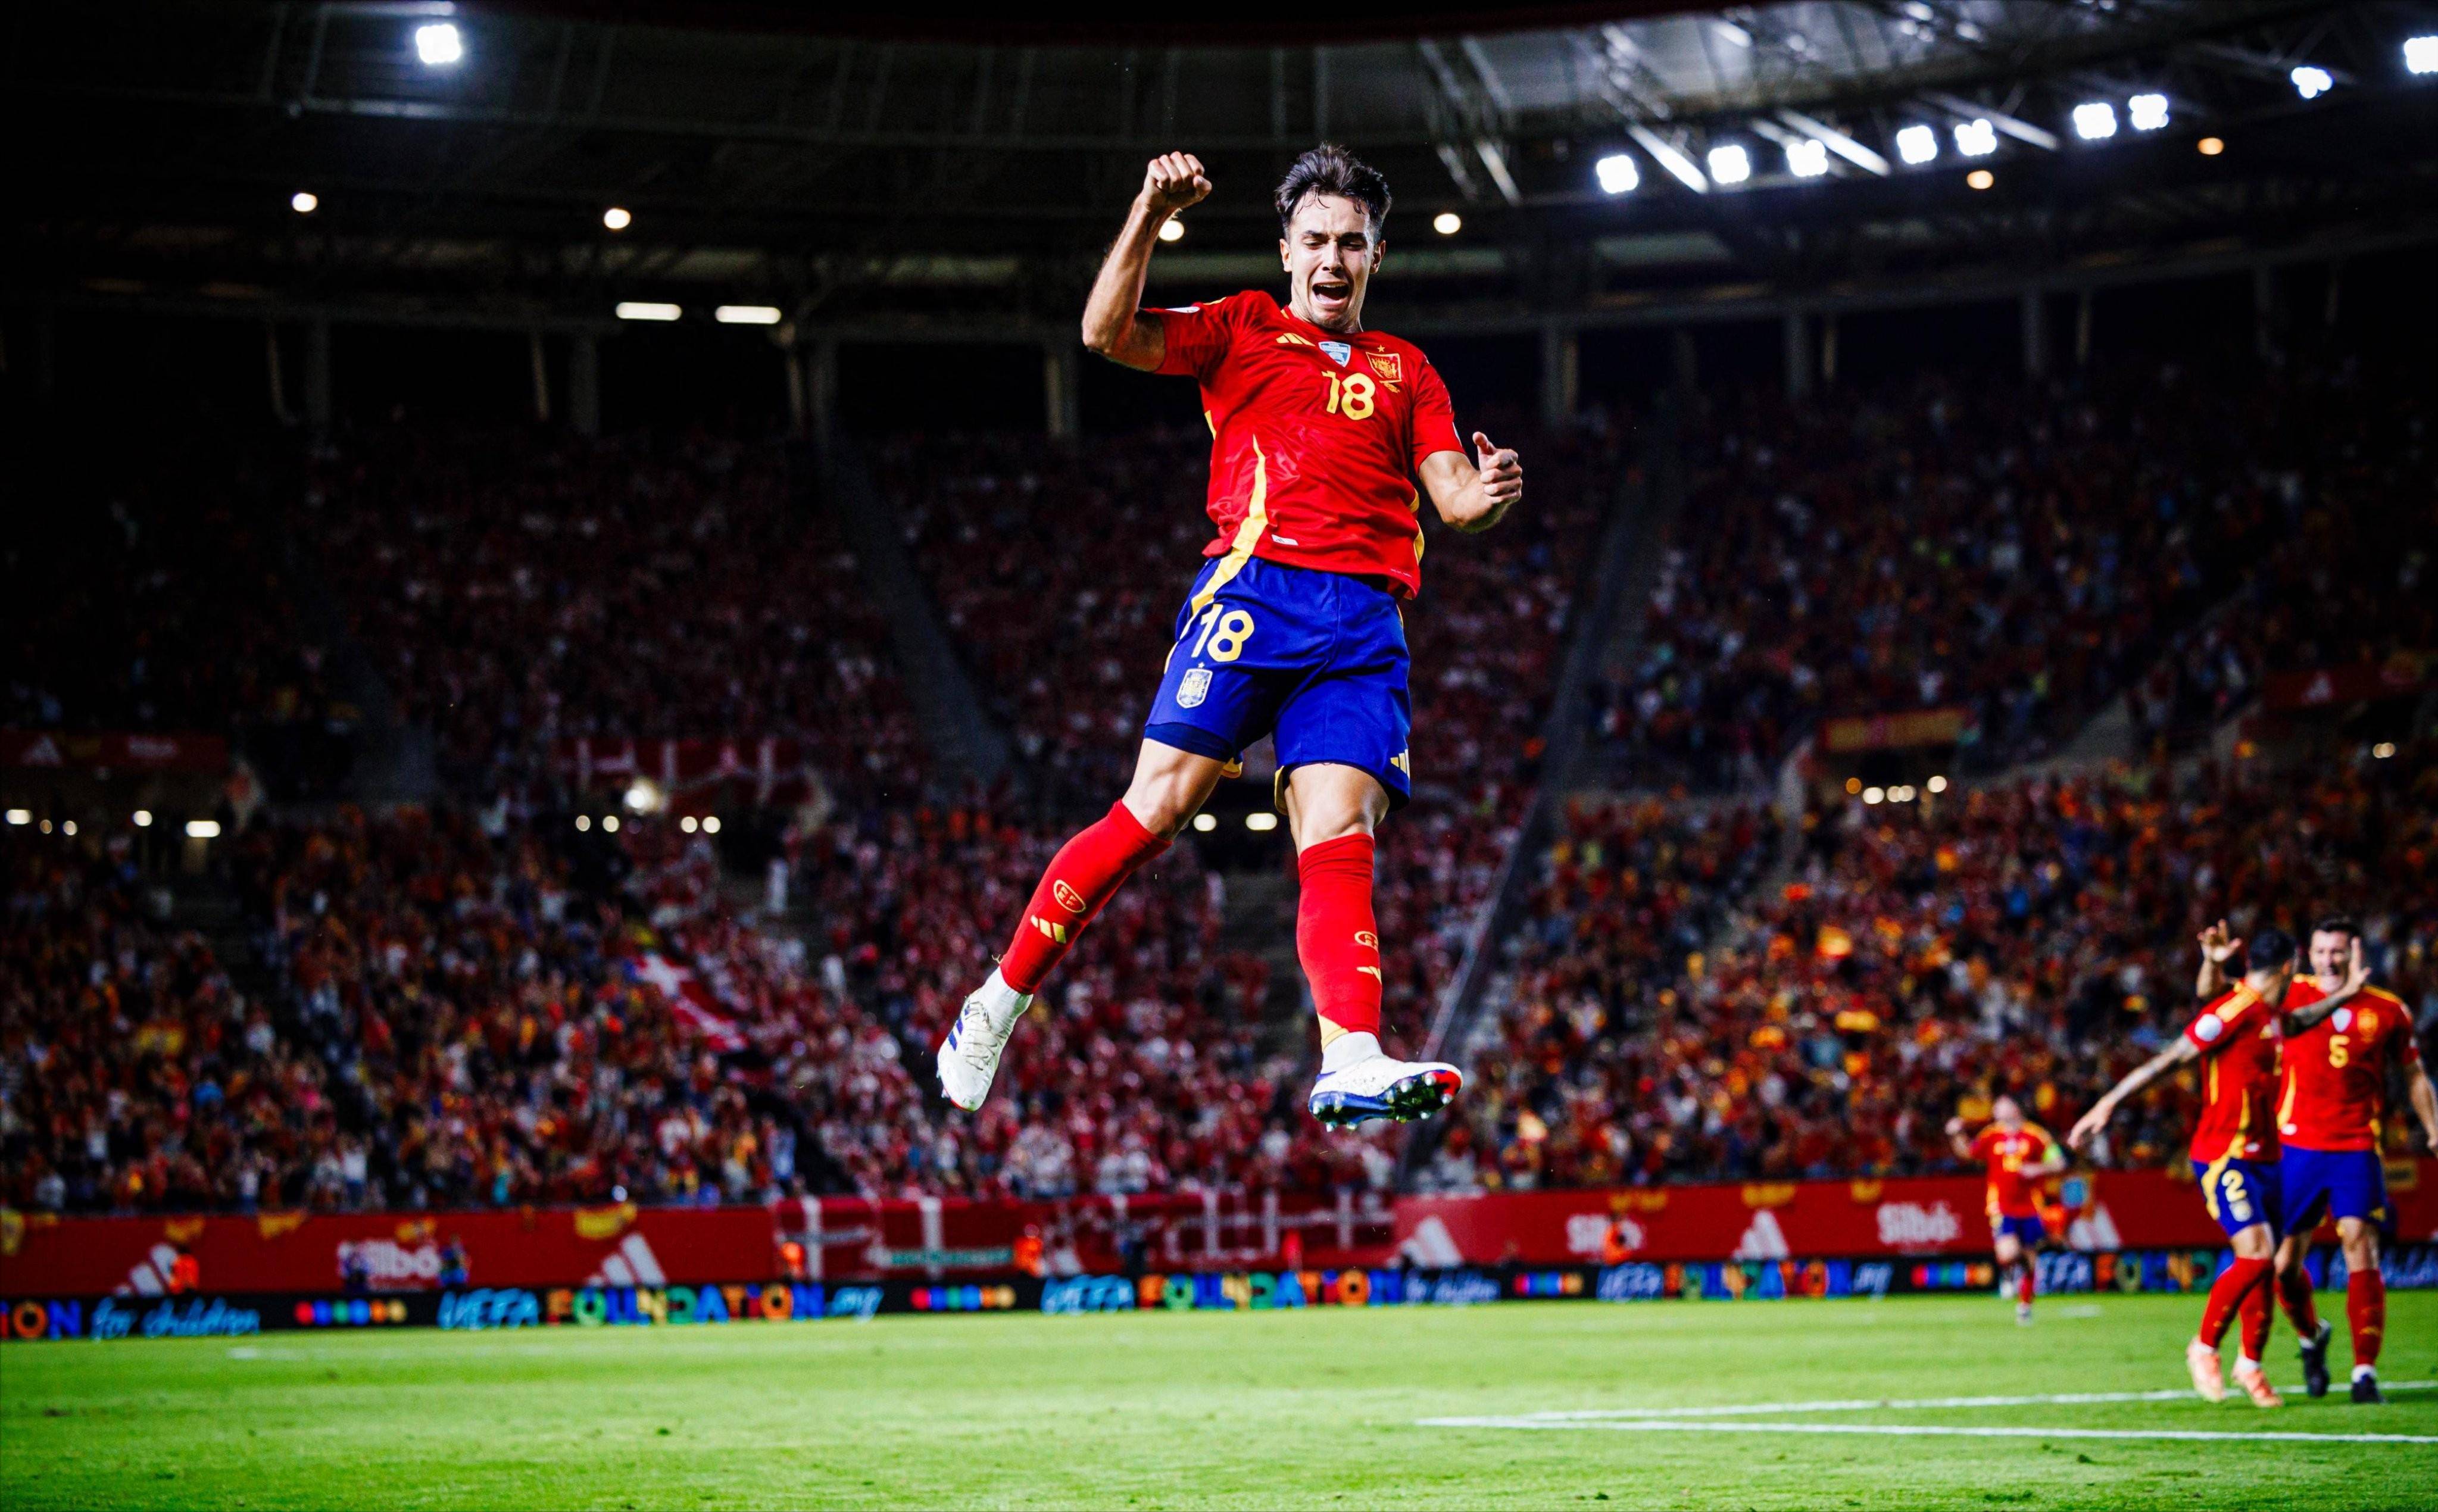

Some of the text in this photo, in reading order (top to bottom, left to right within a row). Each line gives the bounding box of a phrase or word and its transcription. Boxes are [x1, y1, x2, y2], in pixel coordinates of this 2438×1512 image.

[1321, 370, 1375, 420] 18
[1191, 603, 1254, 662] 18
[2328, 1035, 2351, 1069] 5
[2221, 1169, 2247, 1201] 2
[437, 1287, 539, 1330] UEFA
